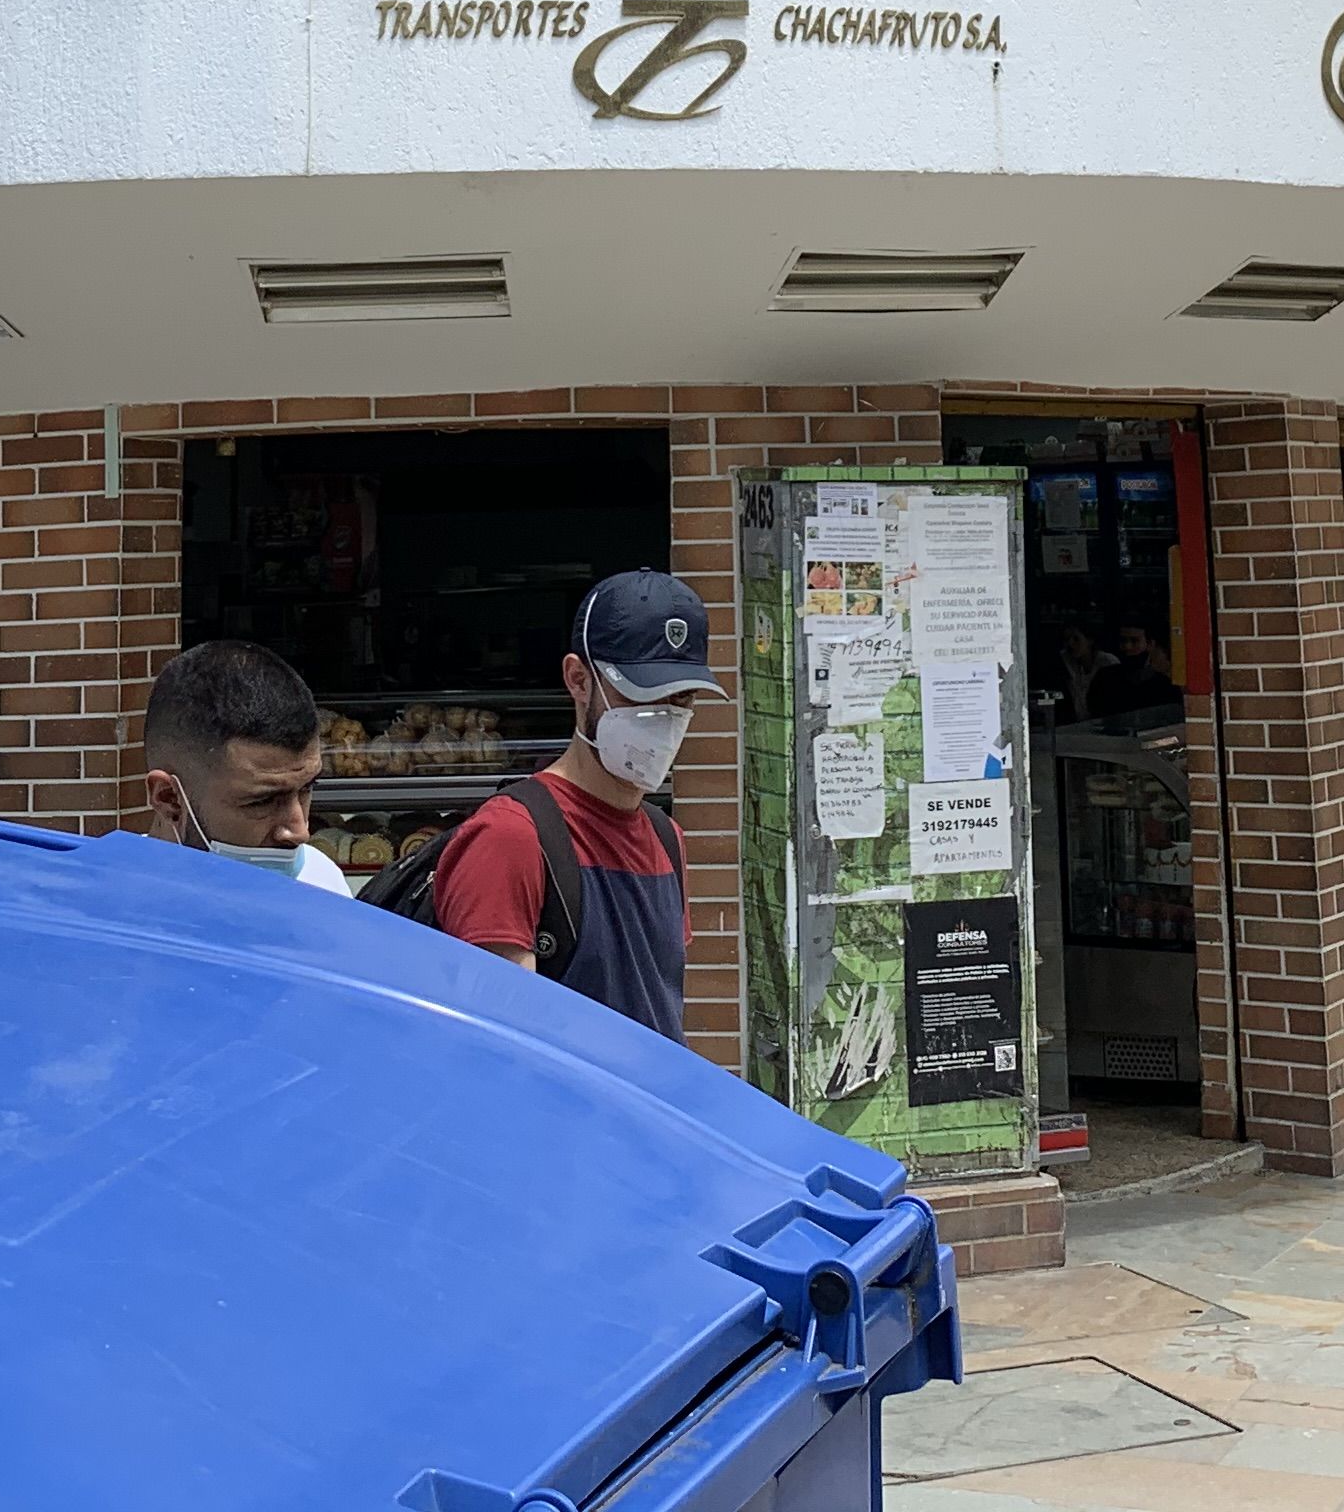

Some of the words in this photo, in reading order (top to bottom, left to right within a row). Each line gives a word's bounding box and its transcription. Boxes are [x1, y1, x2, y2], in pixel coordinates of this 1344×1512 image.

[774, 5, 962, 49] CHACHAFRUTO
[927, 801, 944, 812] SE
[948, 798, 992, 810] VENDE
[922, 817, 998, 832] 3192179445
[929, 835, 959, 846] CASAS
[937, 930, 988, 943] DEFENSA
